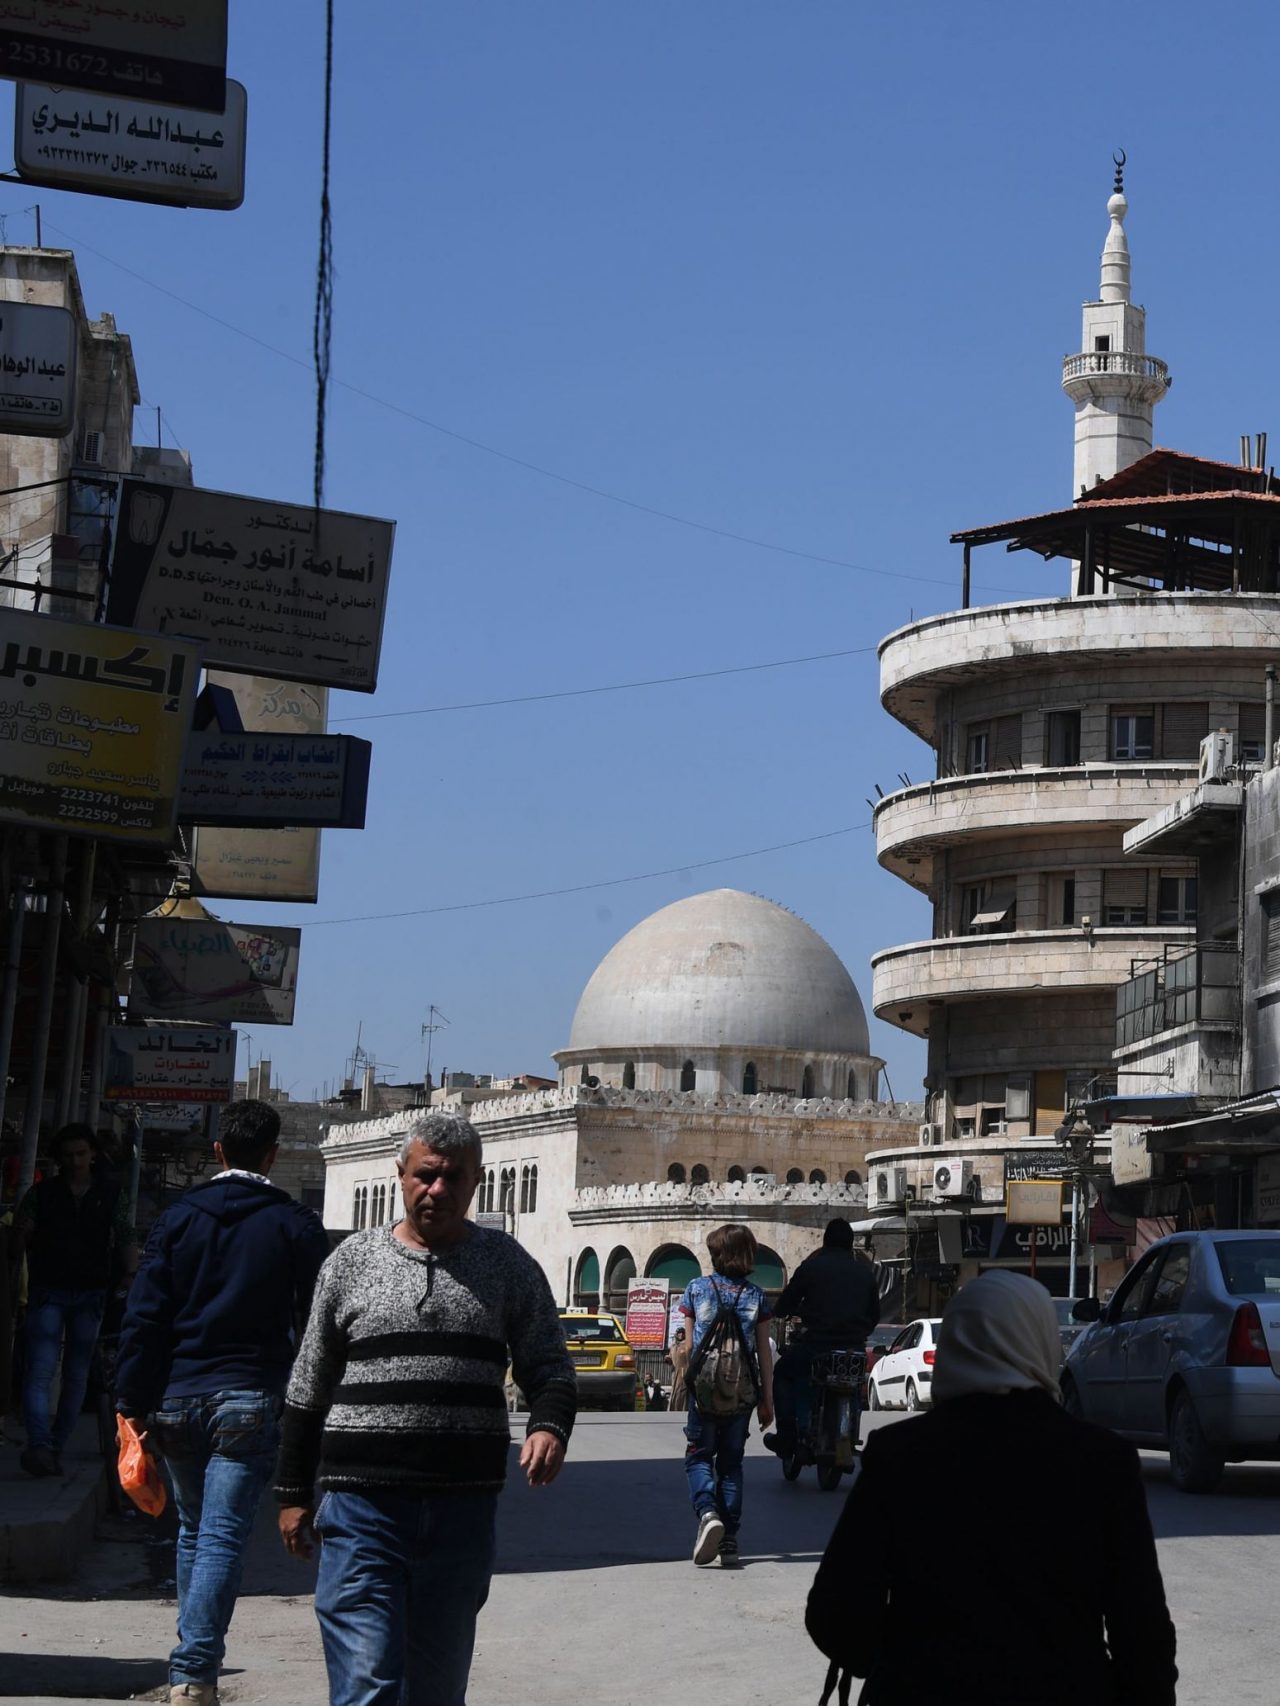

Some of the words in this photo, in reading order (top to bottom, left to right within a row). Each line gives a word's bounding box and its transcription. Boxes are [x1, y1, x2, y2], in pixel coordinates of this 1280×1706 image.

[8, 41, 109, 77] 2531672
[110, 61, 164, 86] هاتف
[32, 104, 120, 139] الديري
[126, 114, 225, 153] عبدالله
[111, 154, 139, 176] جوال
[189, 162, 219, 182] مكتب
[0, 354, 36, 378] الوها
[242, 540, 297, 571] أنور
[203, 591, 235, 607] Den.
[274, 603, 327, 622] Jammal
[56, 706, 141, 737] مطبوعات
[22, 725, 93, 758] بطاقات
[88, 768, 125, 785] سعيد
[127, 772, 161, 792] ياسر
[7, 780, 46, 797] موبايل
[60, 787, 120, 807] 2223741
[58, 804, 119, 823] 2222599
[122, 798, 155, 812] تلفون
[120, 815, 153, 829] فاكس
[138, 1034, 230, 1054] الخالد
[1015, 1226, 1070, 1252] الراقي
